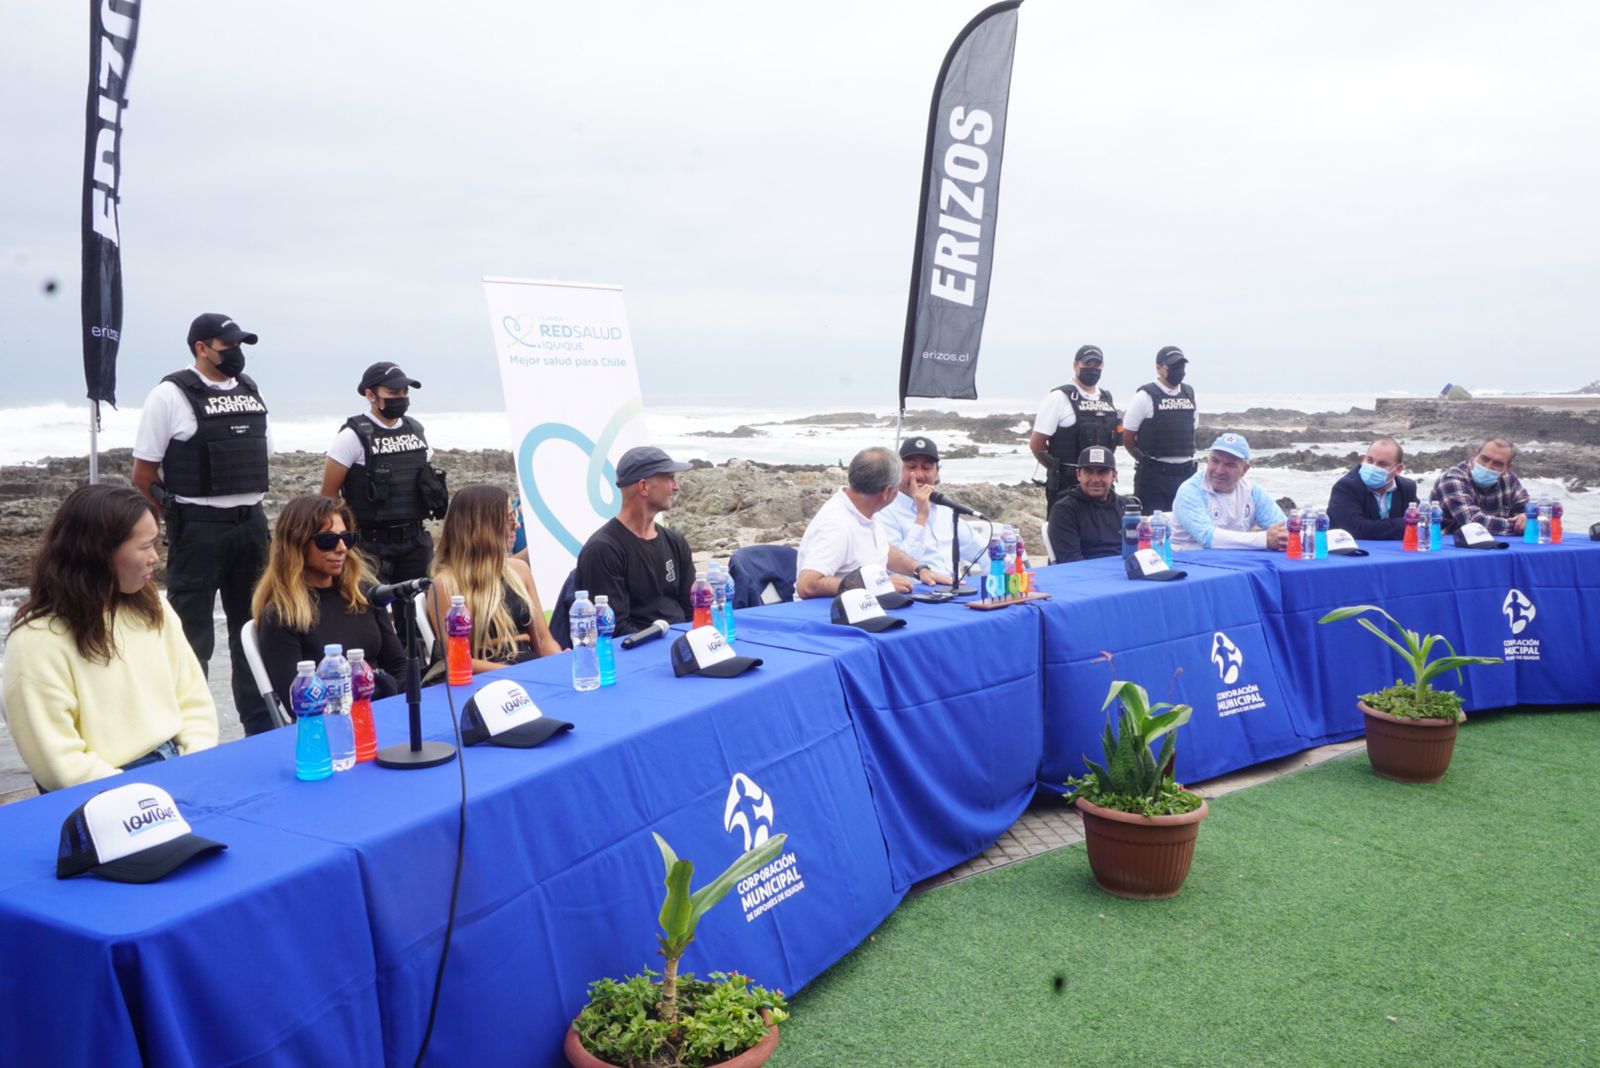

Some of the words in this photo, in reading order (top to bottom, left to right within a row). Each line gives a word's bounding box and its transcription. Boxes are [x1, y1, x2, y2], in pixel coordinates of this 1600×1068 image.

[930, 105, 993, 307] ERIZOS
[540, 324, 622, 340] REDSALUD
[543, 341, 584, 351] IQUIQUE
[510, 355, 540, 367] Mejor
[543, 356, 572, 366] salud
[575, 358, 598, 367] para
[601, 357, 626, 367] Chile
[922, 350, 969, 362] erizos.cl
[205, 402, 266, 415] MARITIMA
[208, 394, 258, 406] POLICIA
[981, 571, 1037, 599] IQUIQUE
[1216, 683, 1259, 700] CORPORACIÓN
[1217, 692, 1264, 711] MUNICIPAL
[737, 852, 797, 895] CORPORACIÓN
[741, 866, 802, 912] MUNICIPAL
[746, 912, 754, 922] DE
[753, 896, 778, 917] DEPORTES
[777, 892, 785, 902] DE
